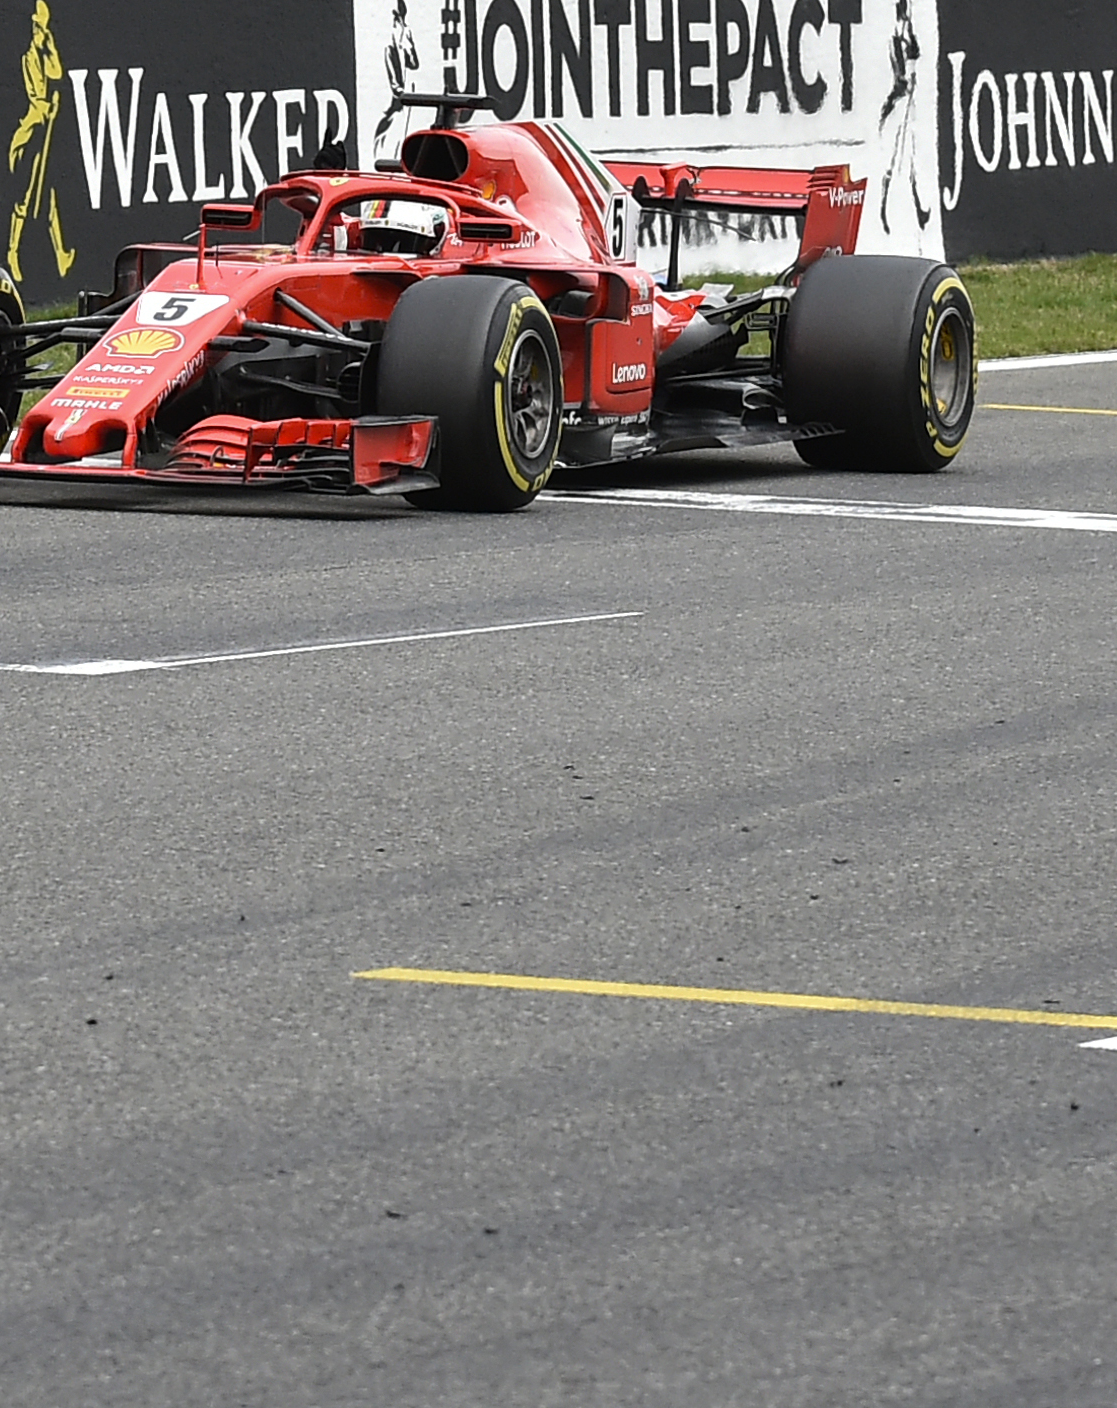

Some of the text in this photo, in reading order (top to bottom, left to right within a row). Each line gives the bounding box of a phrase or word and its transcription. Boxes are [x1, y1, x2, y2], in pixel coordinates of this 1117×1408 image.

[943, 50, 1116, 211] JOHNN
[613, 197, 624, 258] 5
[153, 297, 197, 322] 5
[85, 363, 135, 373] AMD
[612, 362, 647, 384] Lenovo
[50, 398, 123, 410] MAHLE
